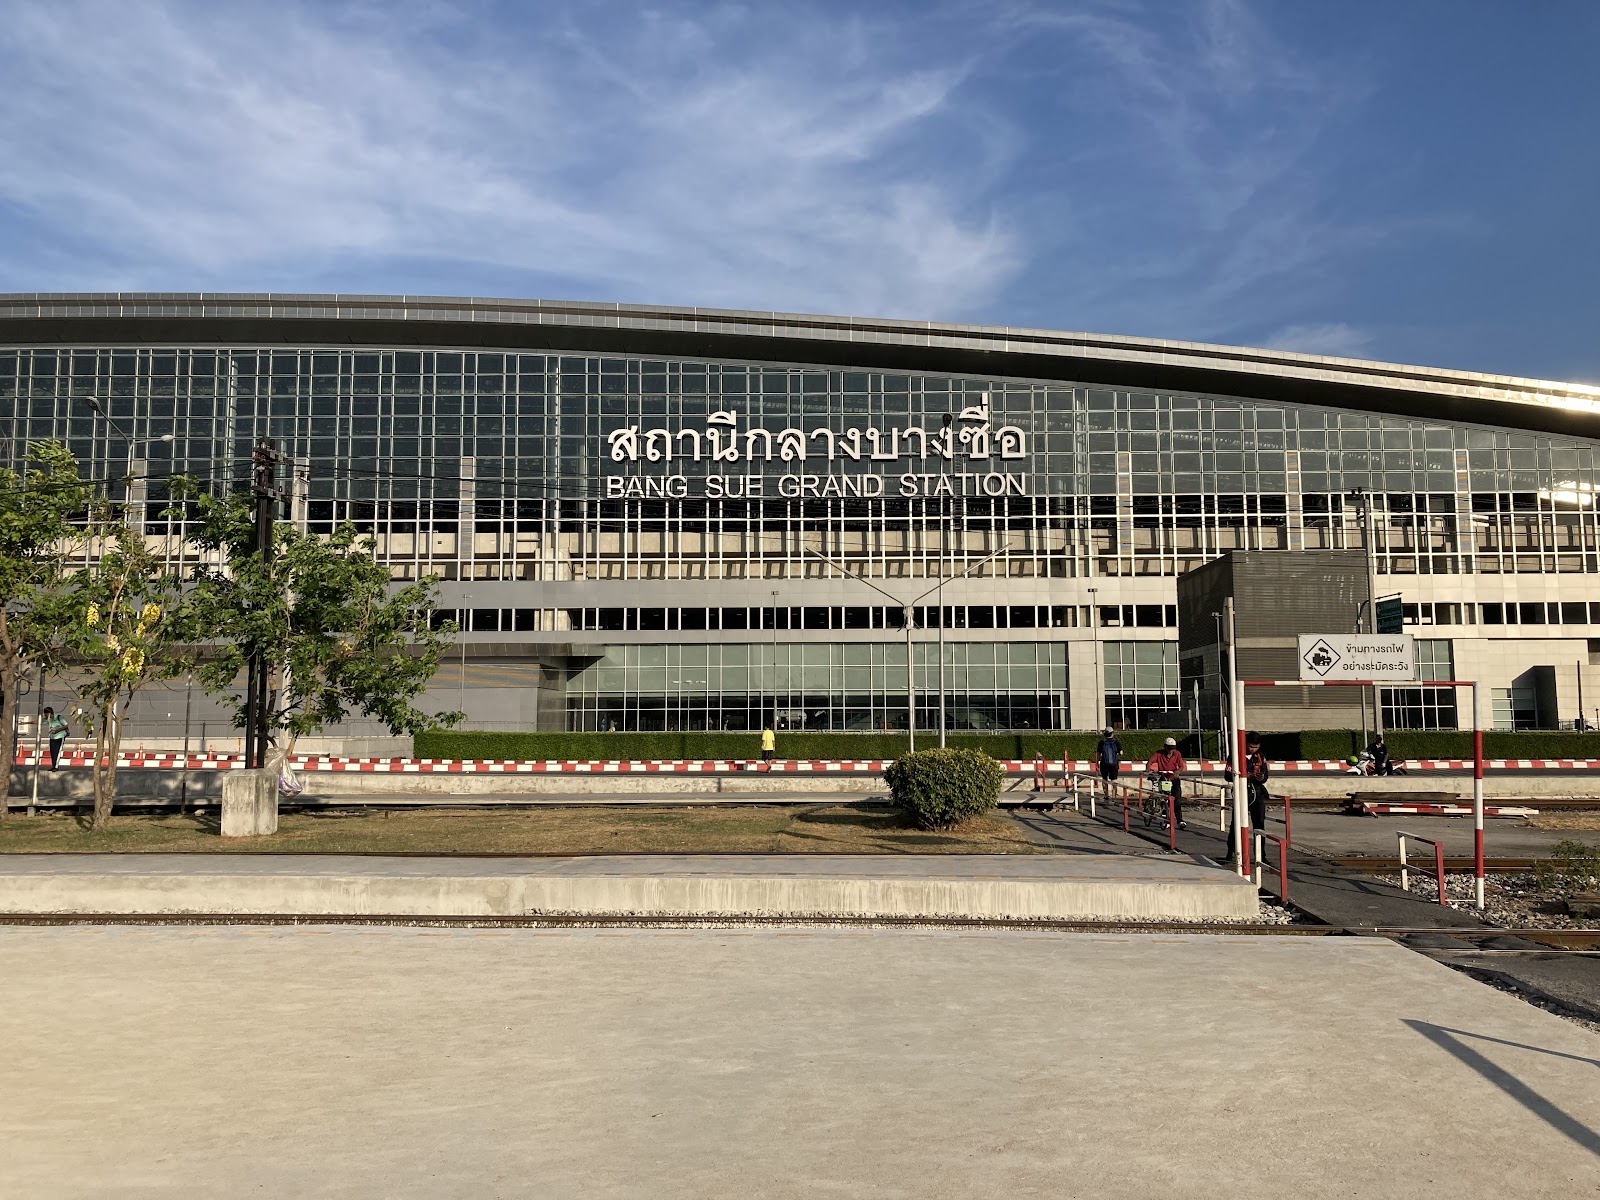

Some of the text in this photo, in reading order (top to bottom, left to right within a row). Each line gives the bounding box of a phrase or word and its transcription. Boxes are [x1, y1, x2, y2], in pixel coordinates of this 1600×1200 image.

[607, 392, 1027, 462] สถานีกลางบางซื่อ
[606, 472, 1026, 499] BANG SUE GRAND STATION
[1346, 644, 1404, 654] ข้ามทางรถไฟ
[1342, 661, 1409, 671] อย่างระมัดระวัง
